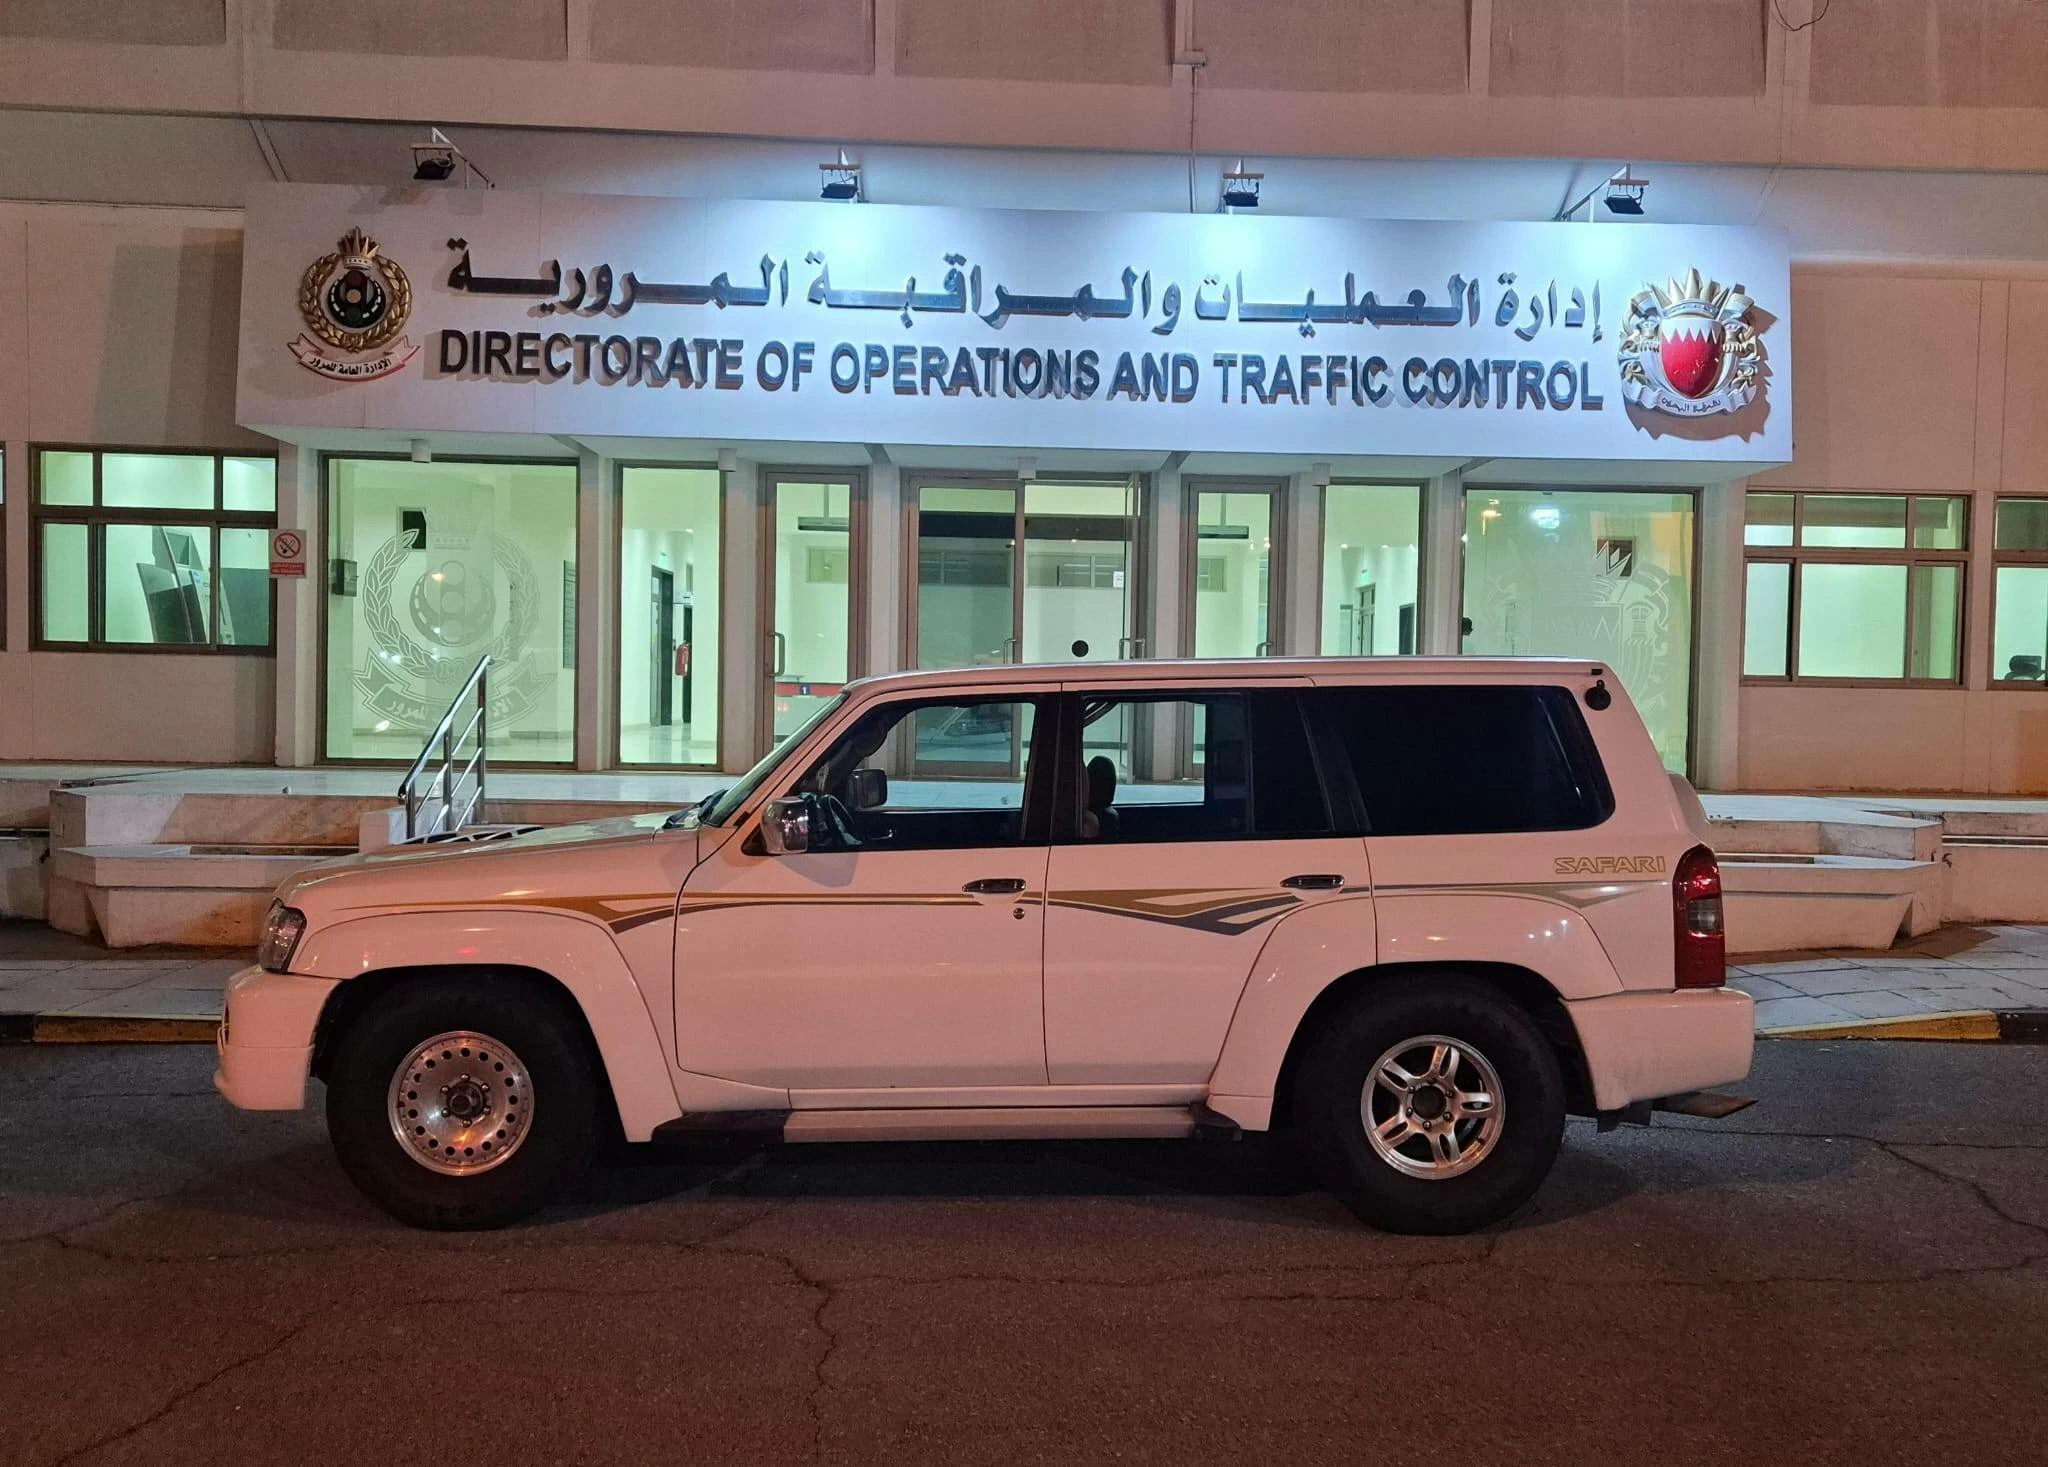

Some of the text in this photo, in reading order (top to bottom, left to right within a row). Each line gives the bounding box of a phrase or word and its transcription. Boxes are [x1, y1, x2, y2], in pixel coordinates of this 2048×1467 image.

[446, 237, 1602, 343] إدارة العمليات والمراقبة المرورية
[439, 328, 1604, 411] DIRECTORATE OF OPERATIONS AND TRAFFIC CONTROL
[1554, 856, 1666, 874] SAFARI
